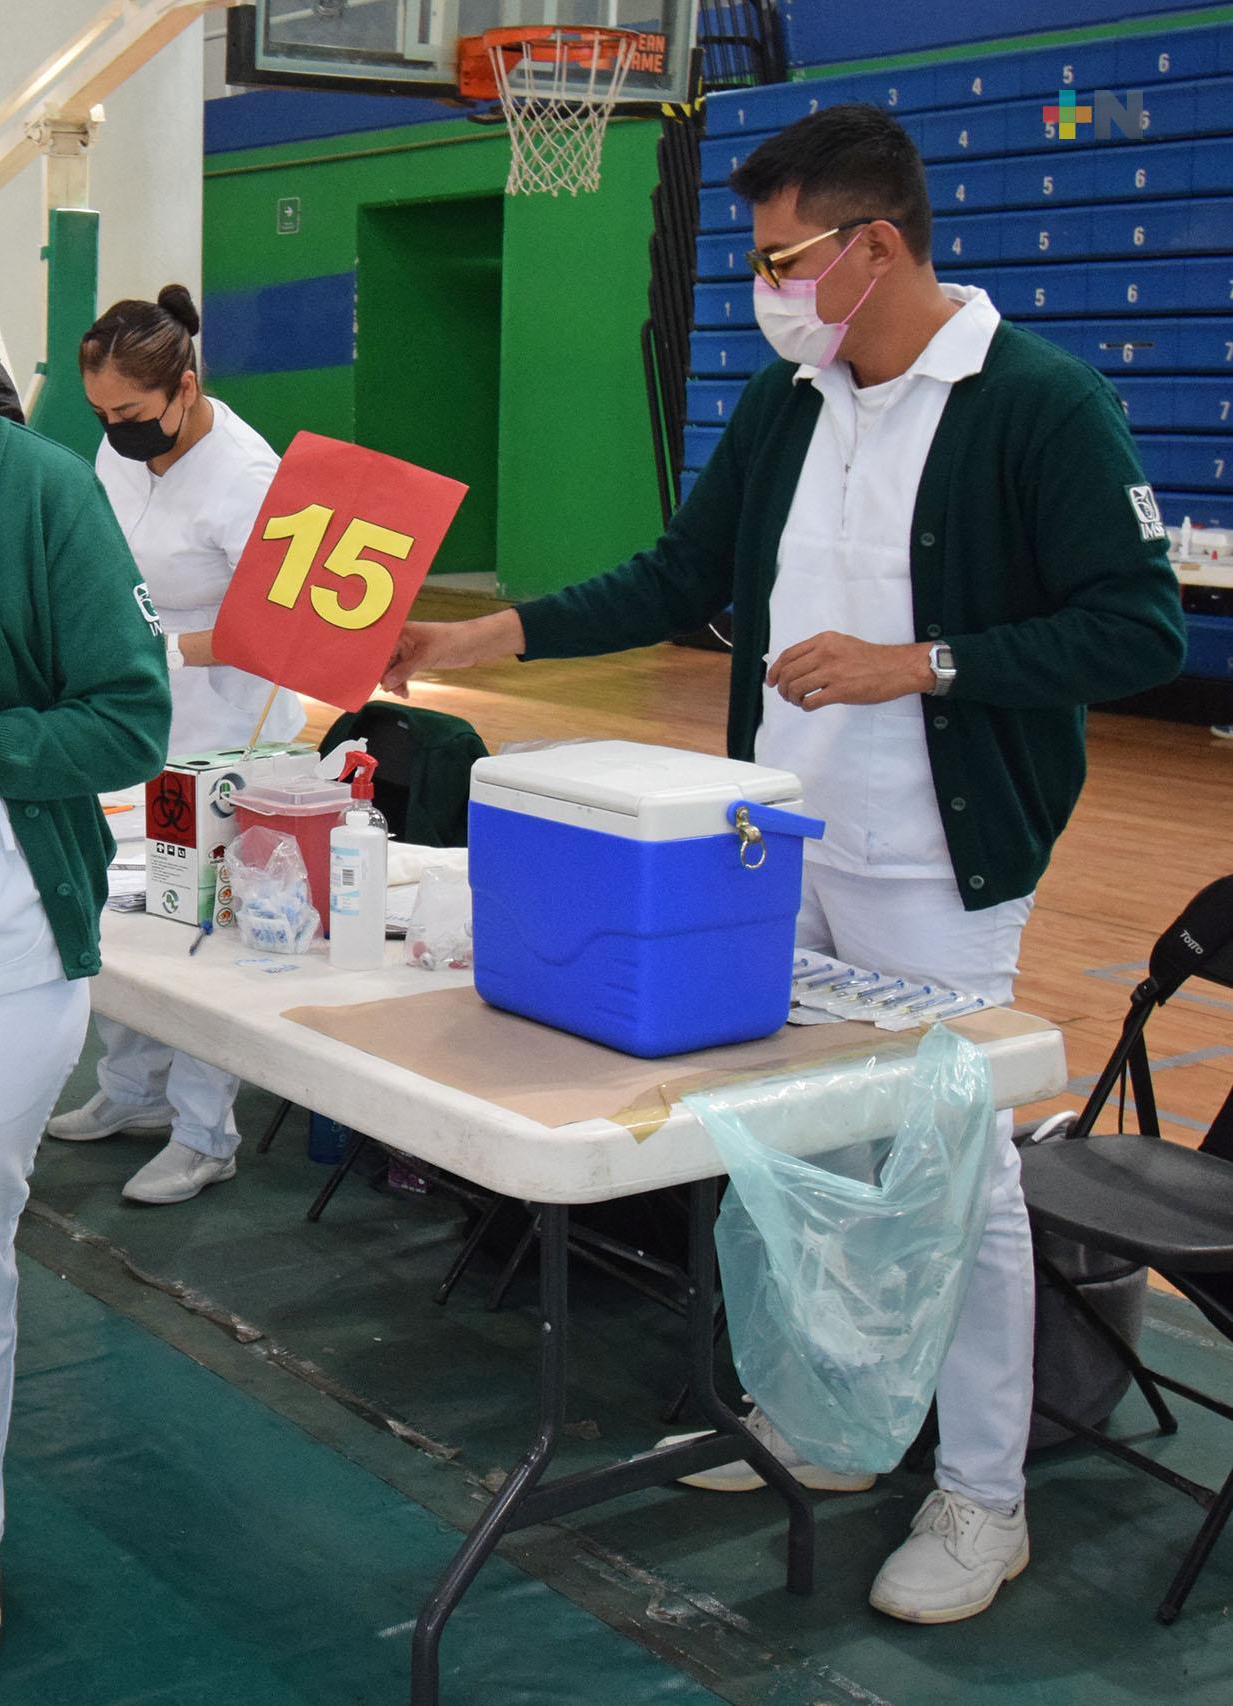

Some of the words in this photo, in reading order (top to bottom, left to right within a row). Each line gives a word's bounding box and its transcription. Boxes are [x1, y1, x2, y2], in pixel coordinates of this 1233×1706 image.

[638, 33, 665, 52] EAN
[631, 52, 663, 73] AME
[1158, 52, 1170, 73] 6
[1062, 64, 1074, 85] 5
[971, 77, 983, 96] 4
[887, 87, 899, 107] 3
[737, 109, 745, 126] 1
[1138, 110, 1151, 130] 6
[958, 130, 969, 148] 4
[1044, 119, 1056, 139] 5
[1042, 175, 1054, 196] 5
[1134, 168, 1147, 189] 6
[955, 183, 966, 203] 4
[729, 204, 737, 221] 1
[951, 236, 962, 256] 4
[1038, 231, 1050, 251] 5
[1133, 226, 1145, 246] 6
[728, 252, 734, 269] 1
[1034, 287, 1046, 308] 5
[1126, 283, 1139, 304] 6
[724, 301, 731, 318] 1
[719, 350, 727, 367] 1
[1122, 342, 1135, 363] 6
[1224, 341, 1233, 362] 7
[716, 399, 724, 416] 1
[1220, 400, 1231, 421] 7
[1214, 459, 1225, 479] 7
[262, 504, 415, 631] 15
